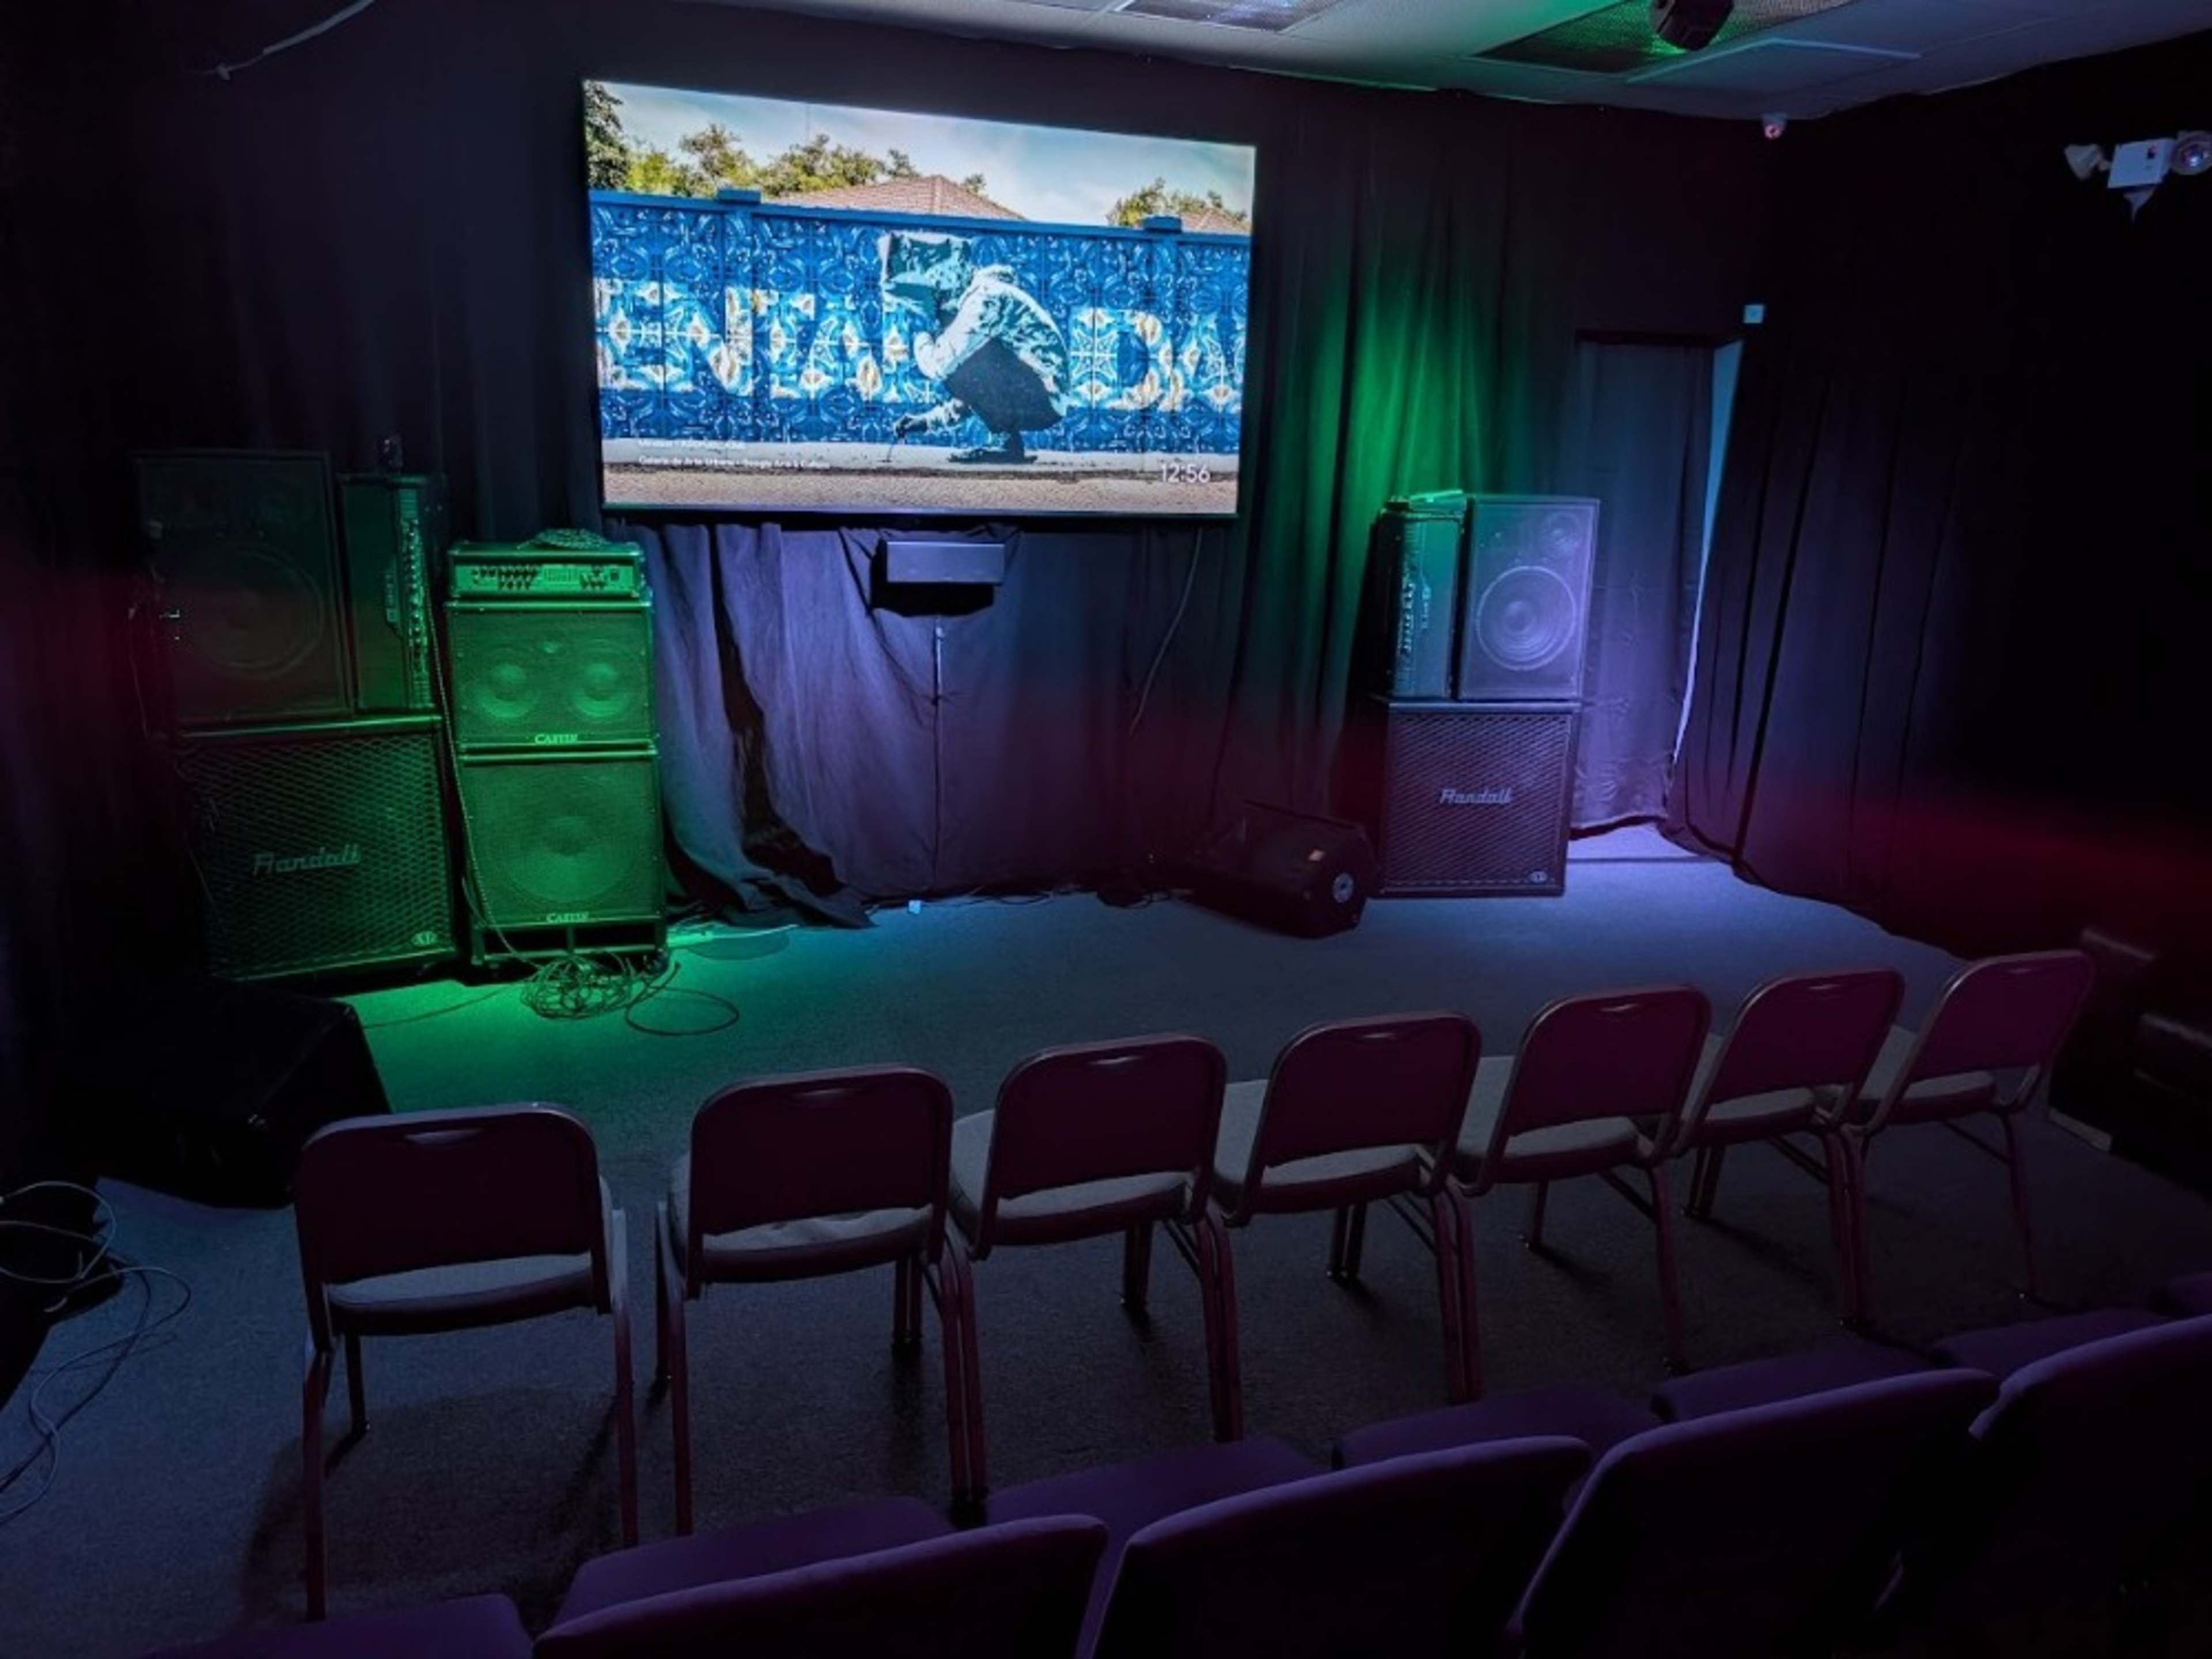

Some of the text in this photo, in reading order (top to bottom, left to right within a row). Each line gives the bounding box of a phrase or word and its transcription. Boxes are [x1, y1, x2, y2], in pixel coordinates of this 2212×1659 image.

[1161, 463, 1210, 483] 12:56
[1440, 786, 1512, 805] Randall
[251, 843, 361, 876] Randall
